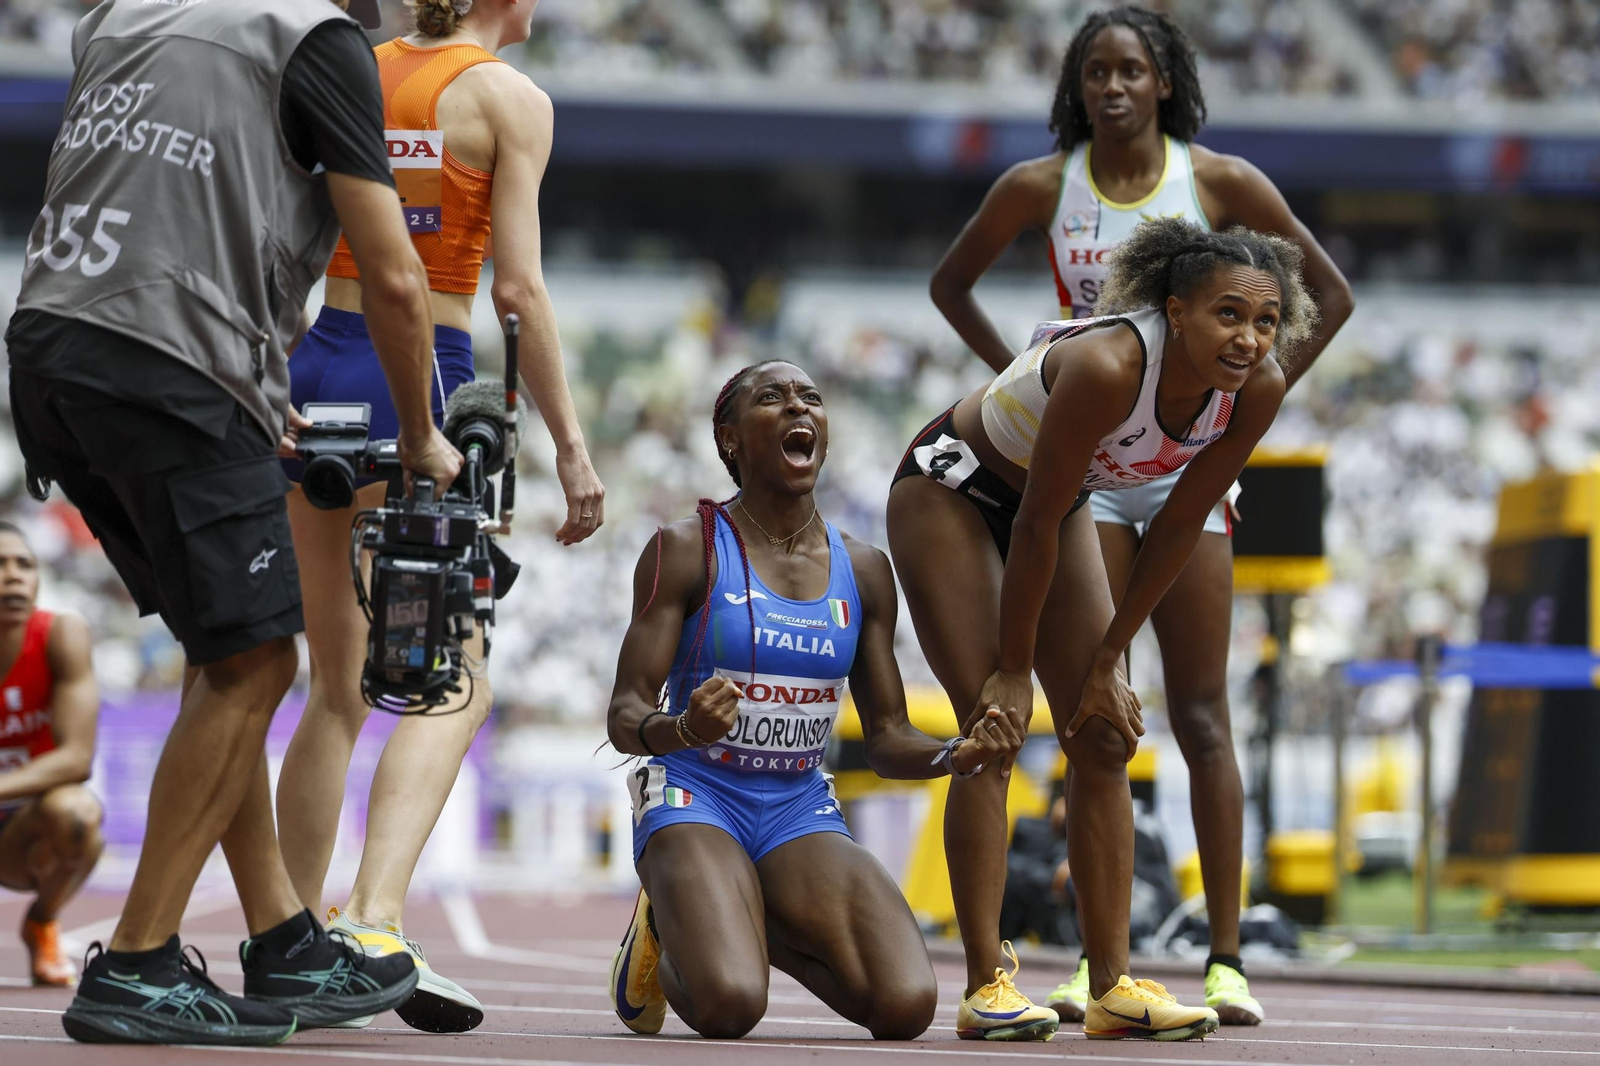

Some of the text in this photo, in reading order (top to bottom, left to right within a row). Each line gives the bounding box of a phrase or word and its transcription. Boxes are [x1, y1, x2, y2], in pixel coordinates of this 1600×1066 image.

[766, 612, 828, 627] FRECCIAROSSA
[754, 627, 836, 658] ITALIA
[726, 714, 831, 749] OLORUNSO
[634, 766, 651, 811] 2
